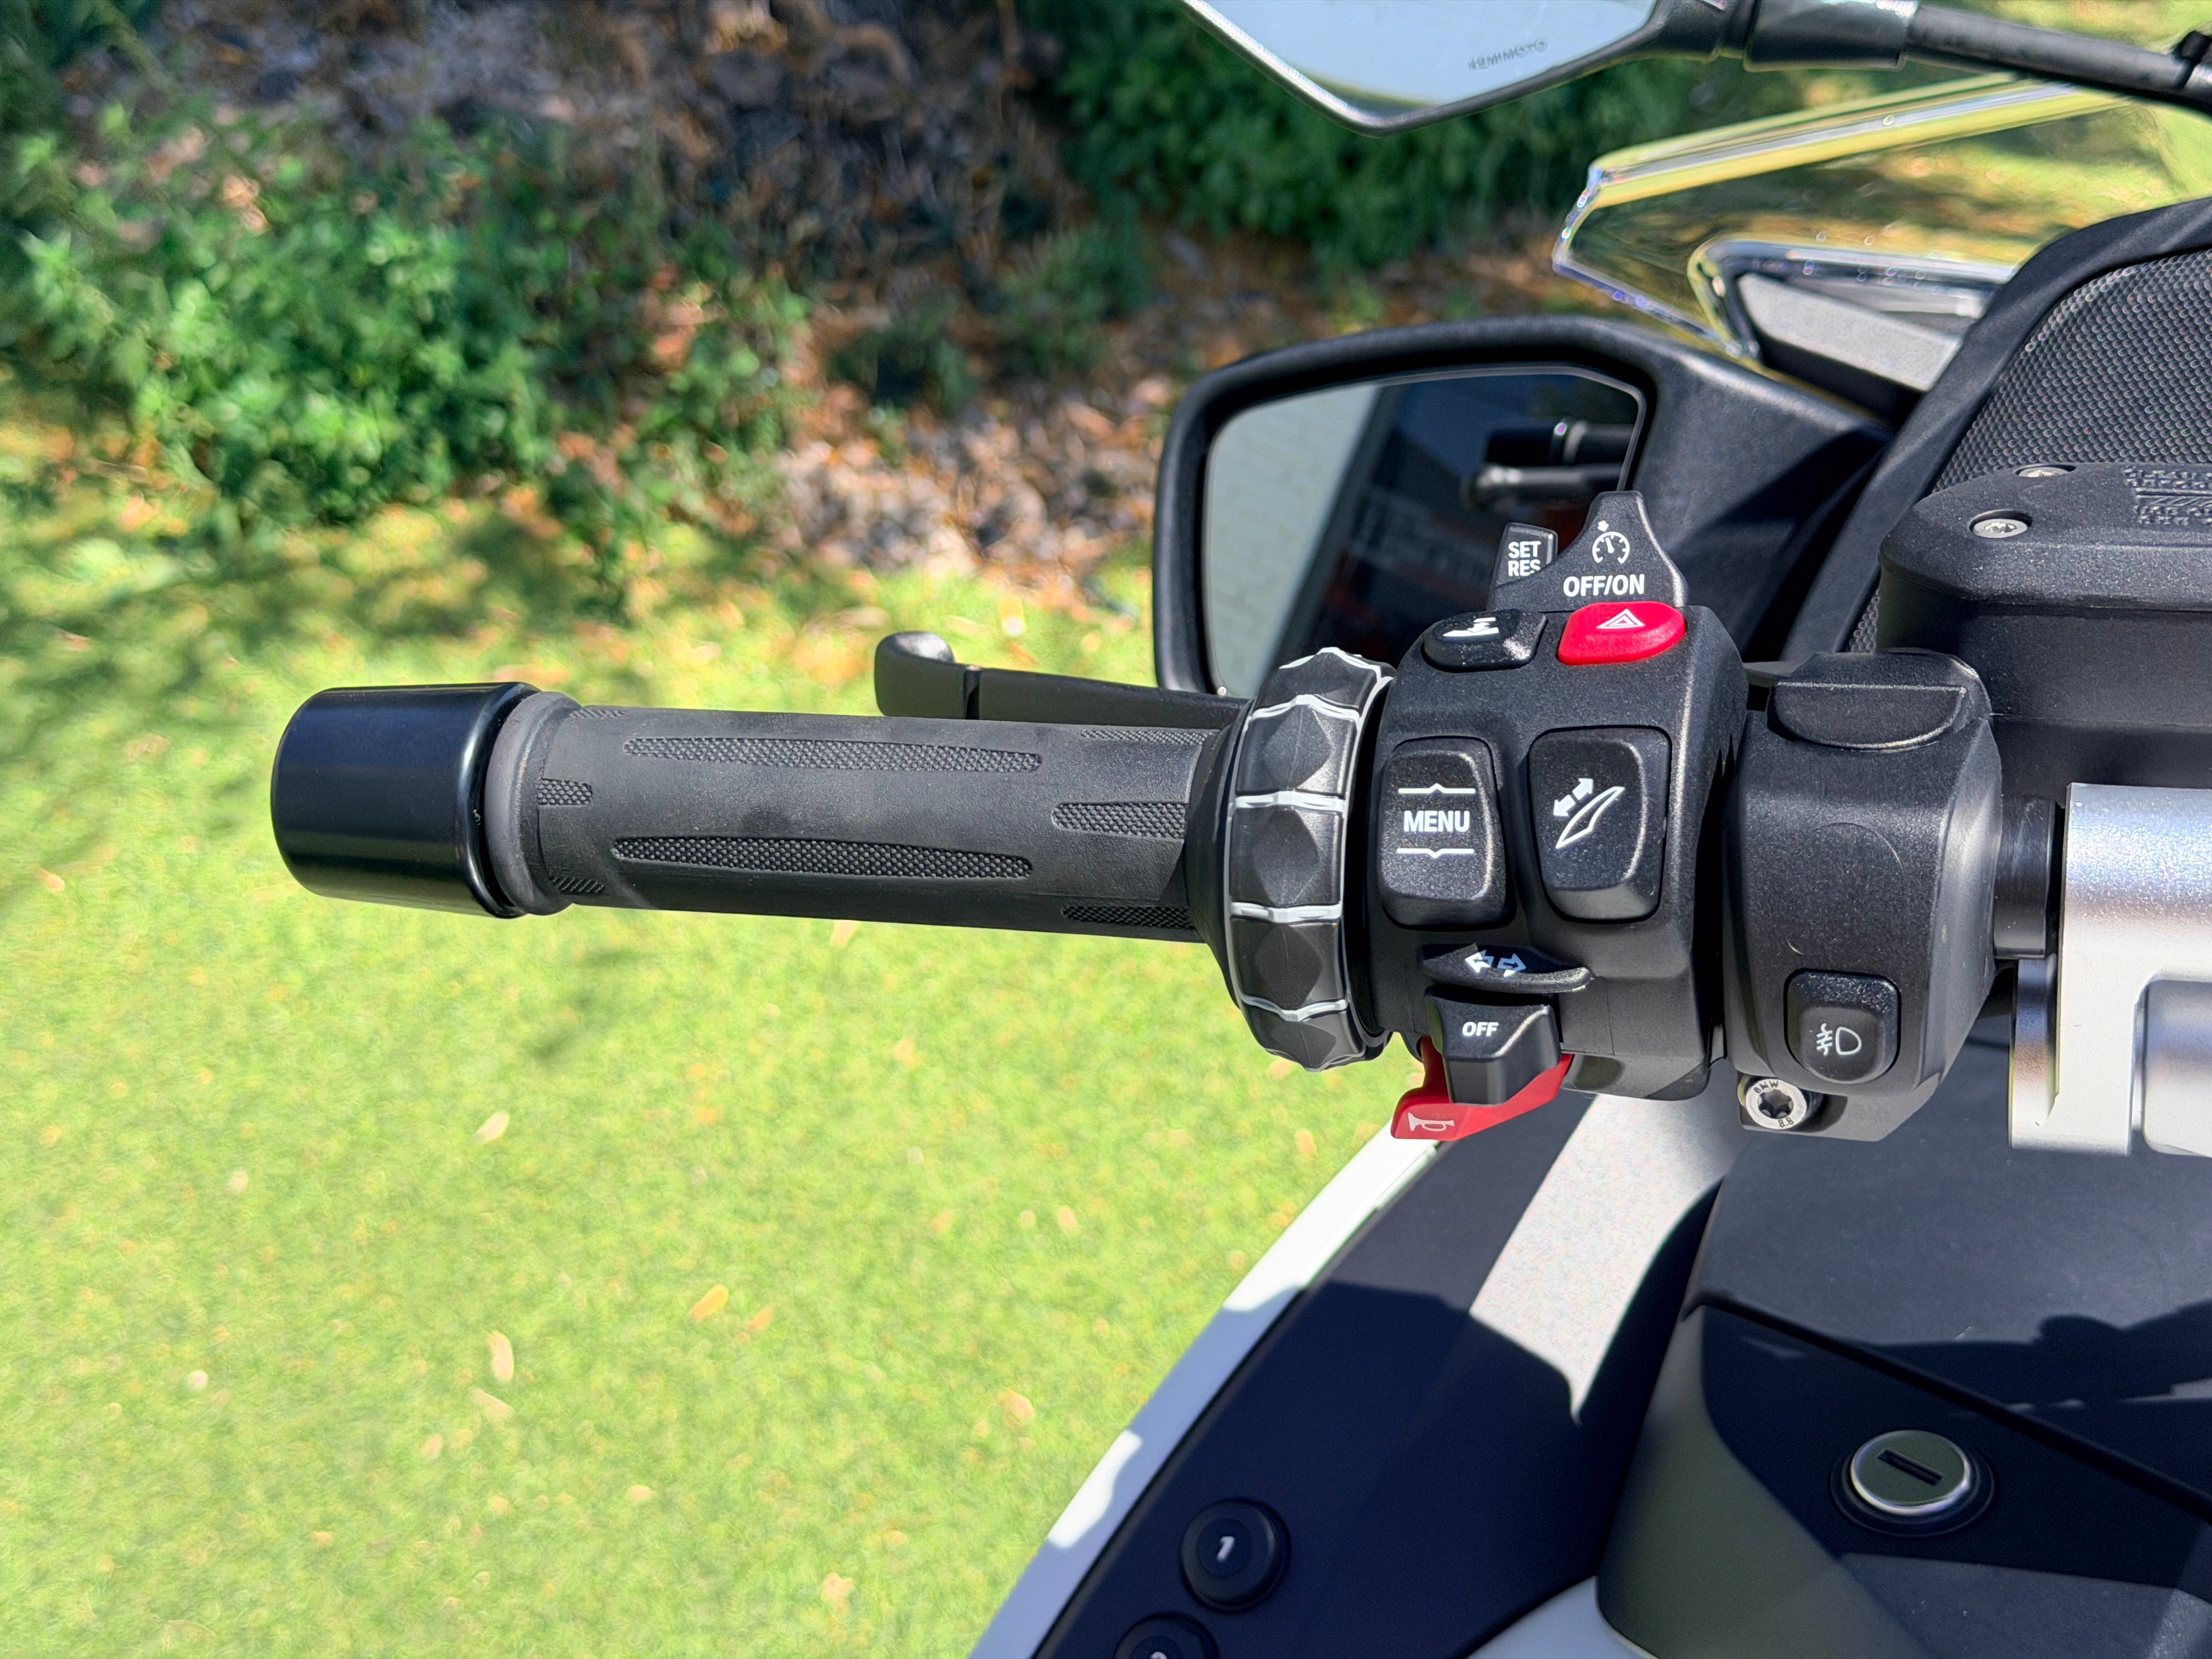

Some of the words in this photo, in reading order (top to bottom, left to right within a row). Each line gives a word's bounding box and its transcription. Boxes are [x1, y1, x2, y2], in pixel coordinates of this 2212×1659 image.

[1508, 541, 1541, 558] SET
[1508, 560, 1541, 577] RES
[1564, 574, 1645, 597] OFF/ON
[1403, 810, 1470, 832] MENU
[1462, 1022, 1499, 1037] OFF
[1753, 1080, 1779, 1094] BMW
[1217, 1536, 1235, 1562] 1
